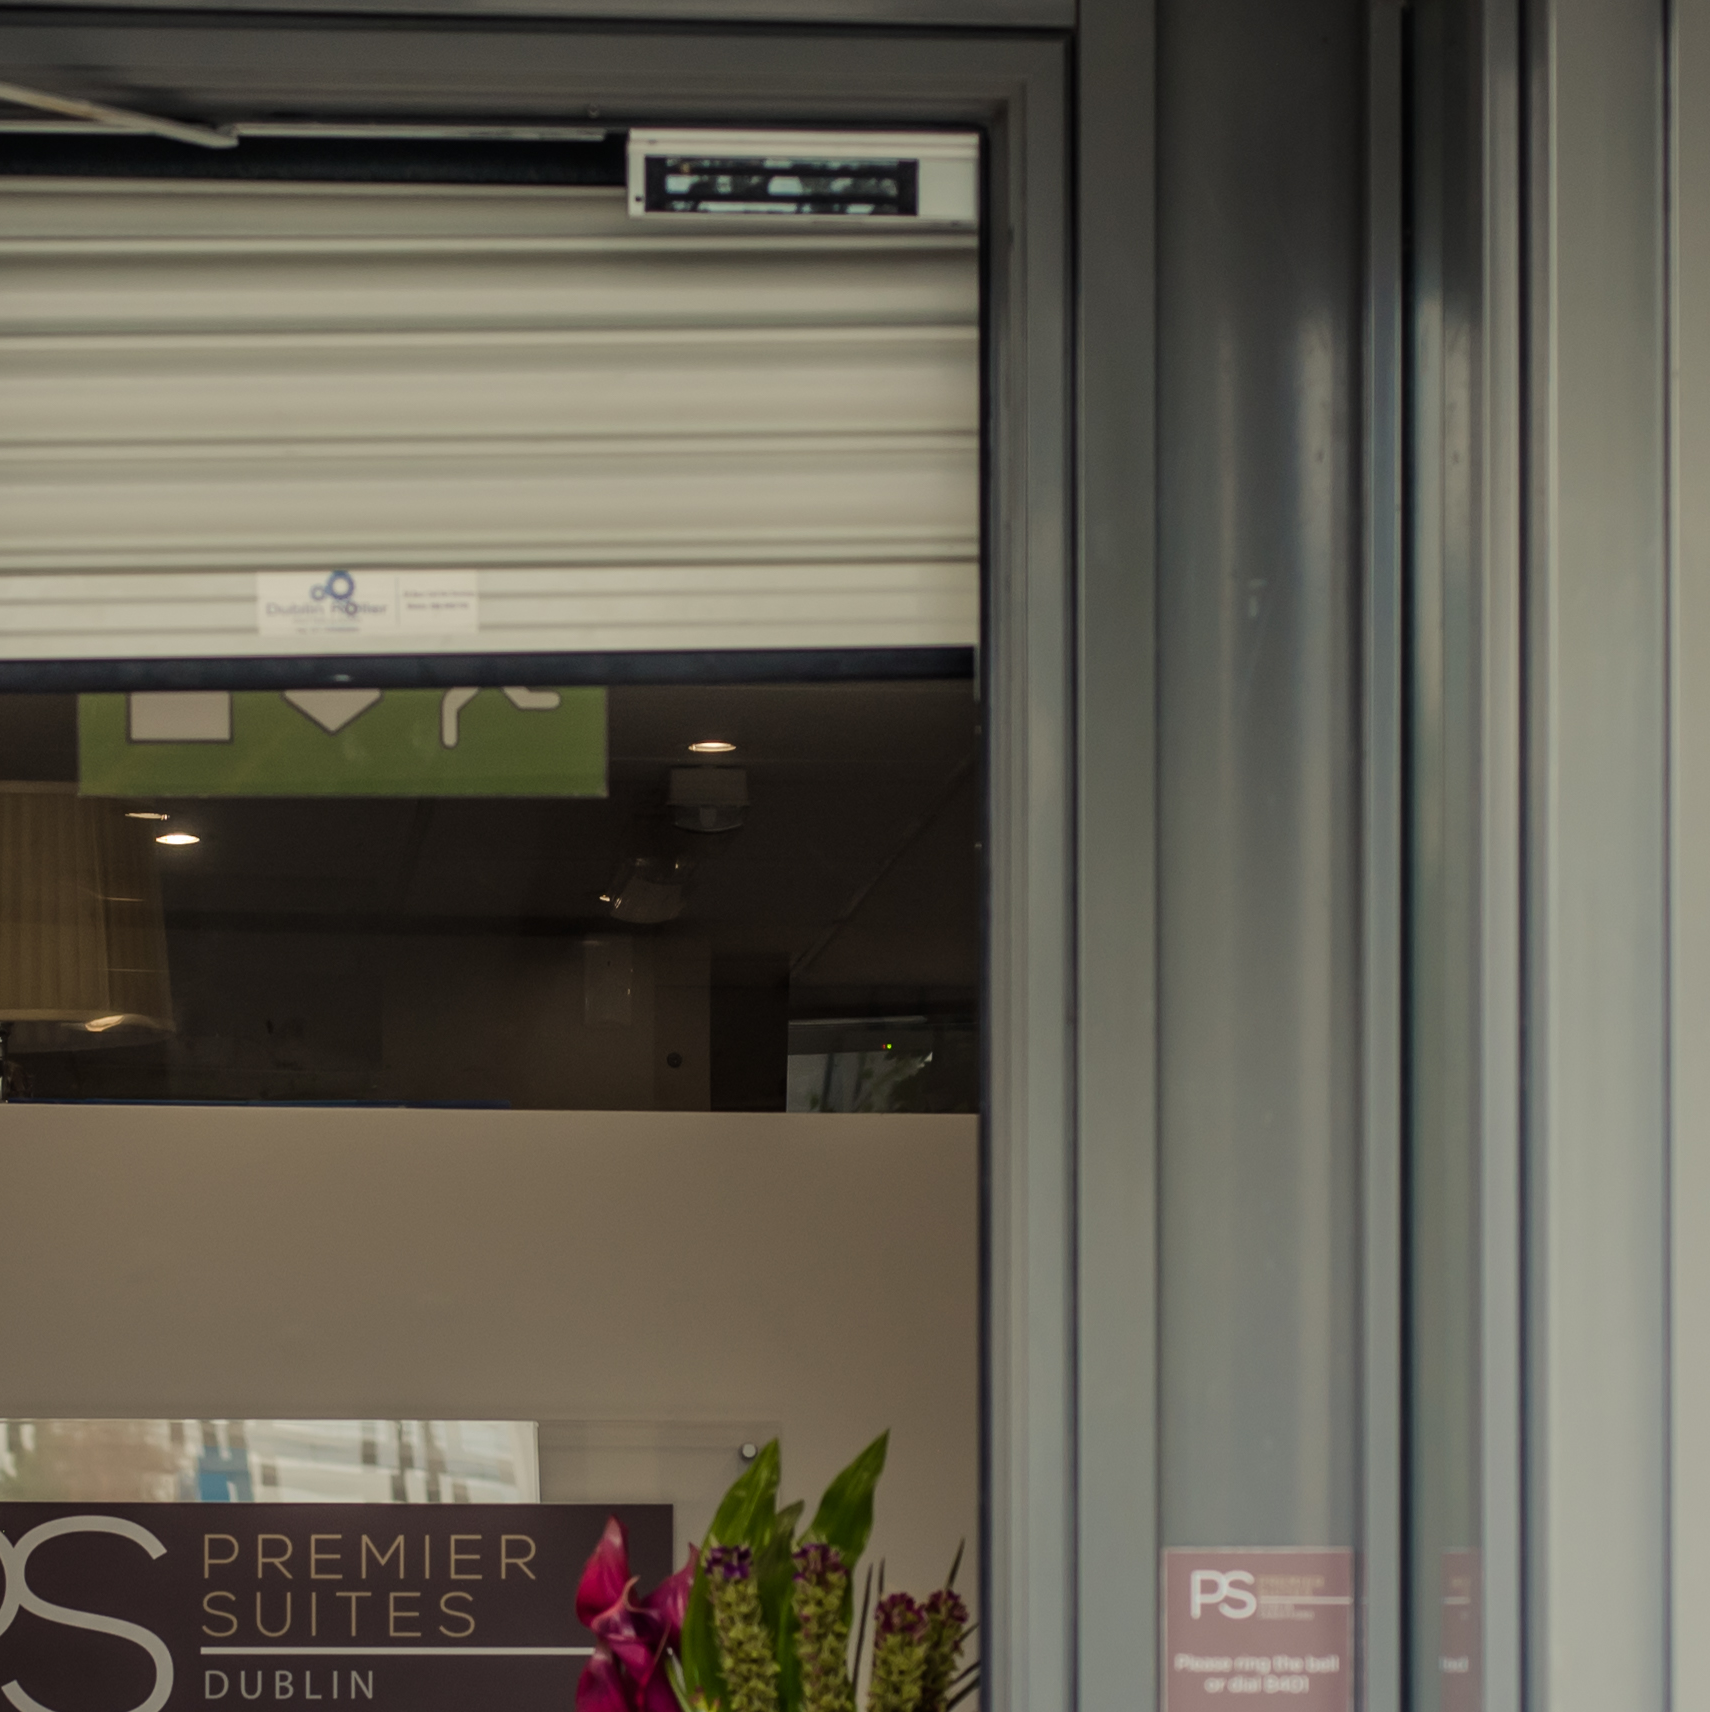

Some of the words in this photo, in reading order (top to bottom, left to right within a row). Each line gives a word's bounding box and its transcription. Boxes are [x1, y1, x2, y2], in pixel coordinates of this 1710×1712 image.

[201, 1533, 539, 1581] PREMIER
[201, 1590, 478, 1639] SUITES
[1190, 1569, 1257, 1620] PS
[204, 1670, 376, 1701] DUBLIN
[1233, 1654, 1271, 1676] ring
[1272, 1653, 1304, 1673] the
[1305, 1653, 1340, 1673] bell
